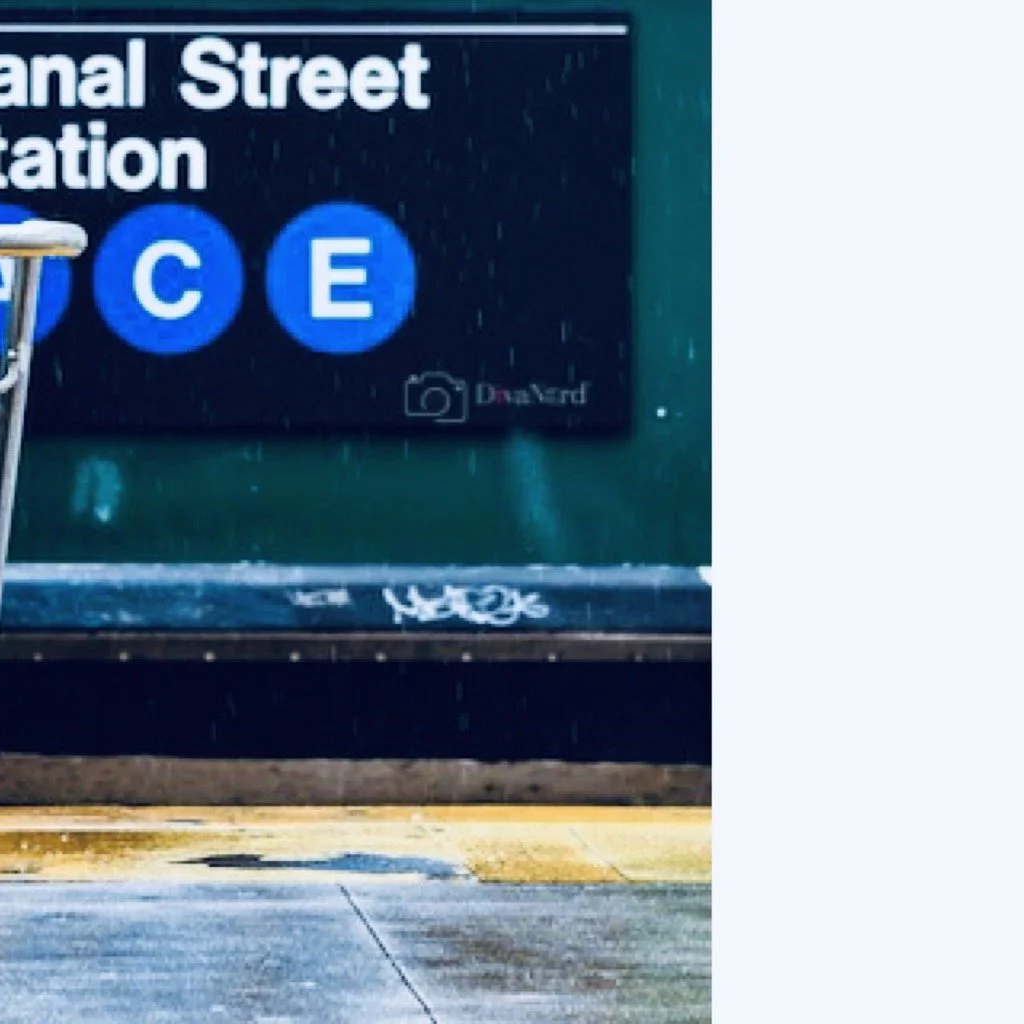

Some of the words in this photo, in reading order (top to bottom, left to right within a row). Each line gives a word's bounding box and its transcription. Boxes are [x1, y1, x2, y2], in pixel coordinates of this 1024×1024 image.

[179, 37, 430, 110] Street
[132, 240, 202, 319] C
[310, 238, 372, 319] E
